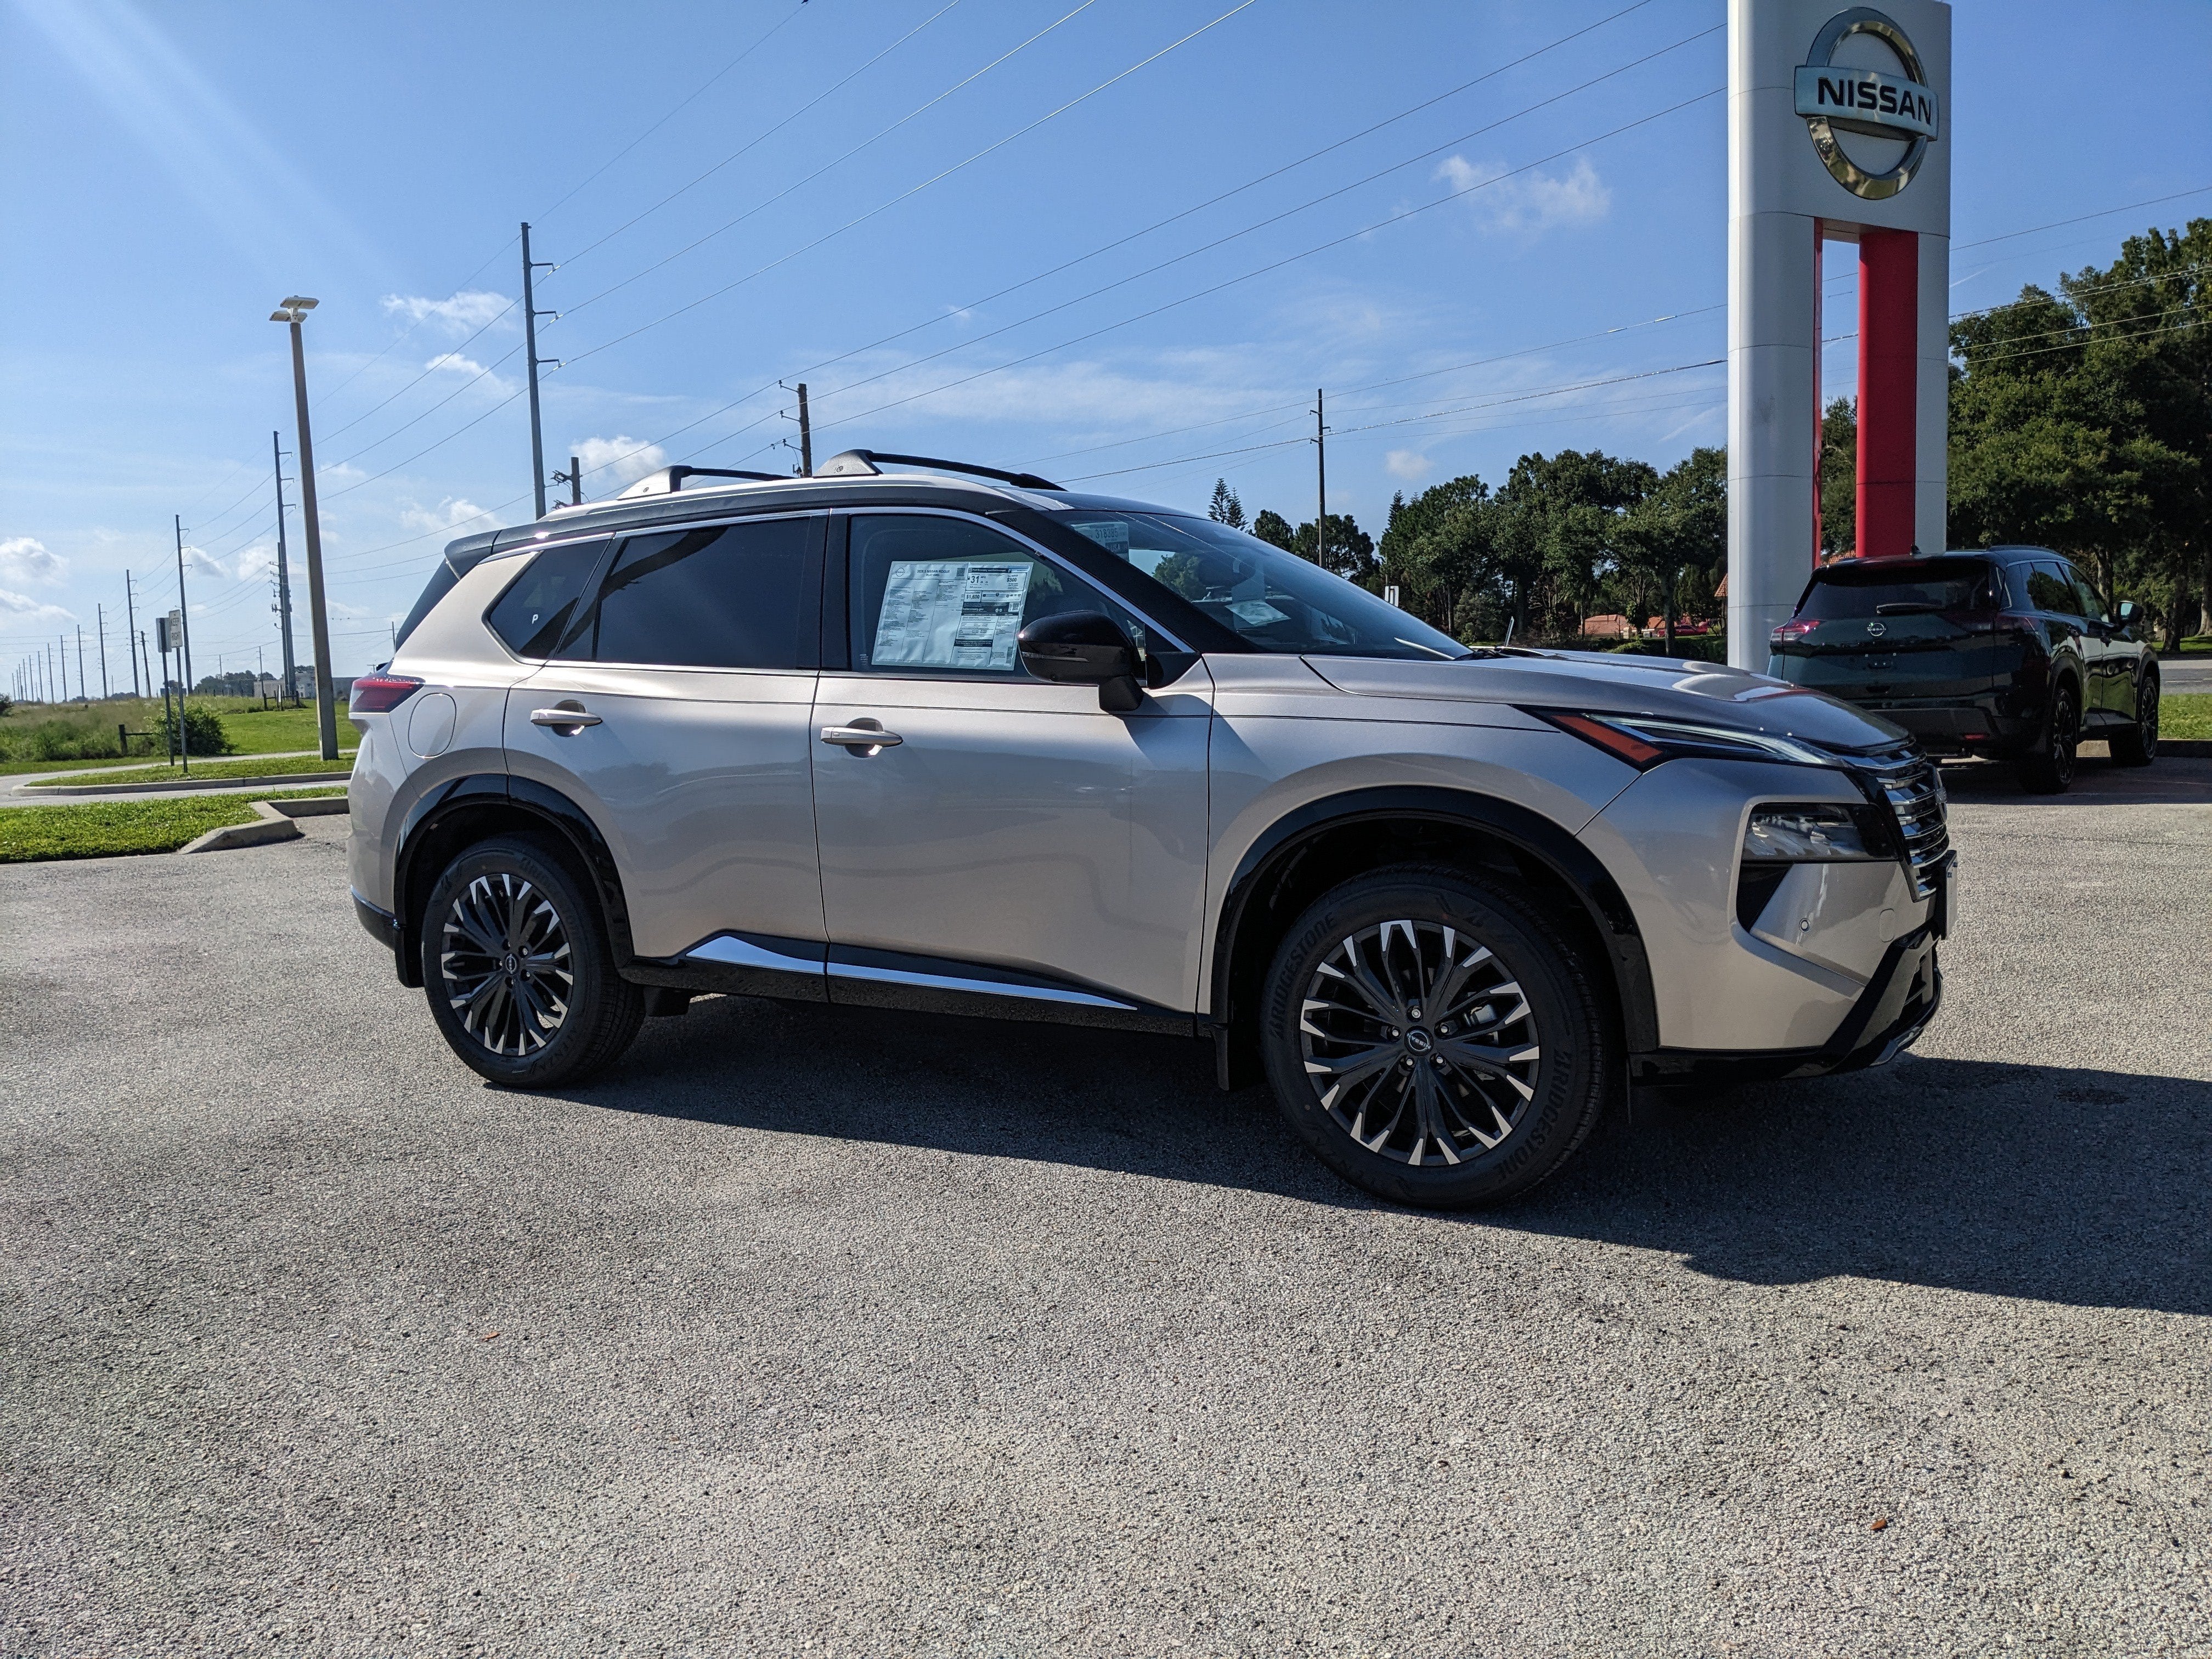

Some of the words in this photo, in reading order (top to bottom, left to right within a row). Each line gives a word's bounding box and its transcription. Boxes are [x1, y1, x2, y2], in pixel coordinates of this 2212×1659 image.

[1818, 77, 1932, 125] NISSAN
[532, 614, 539, 624] P
[1407, 1033, 1431, 1049] NISSAN
